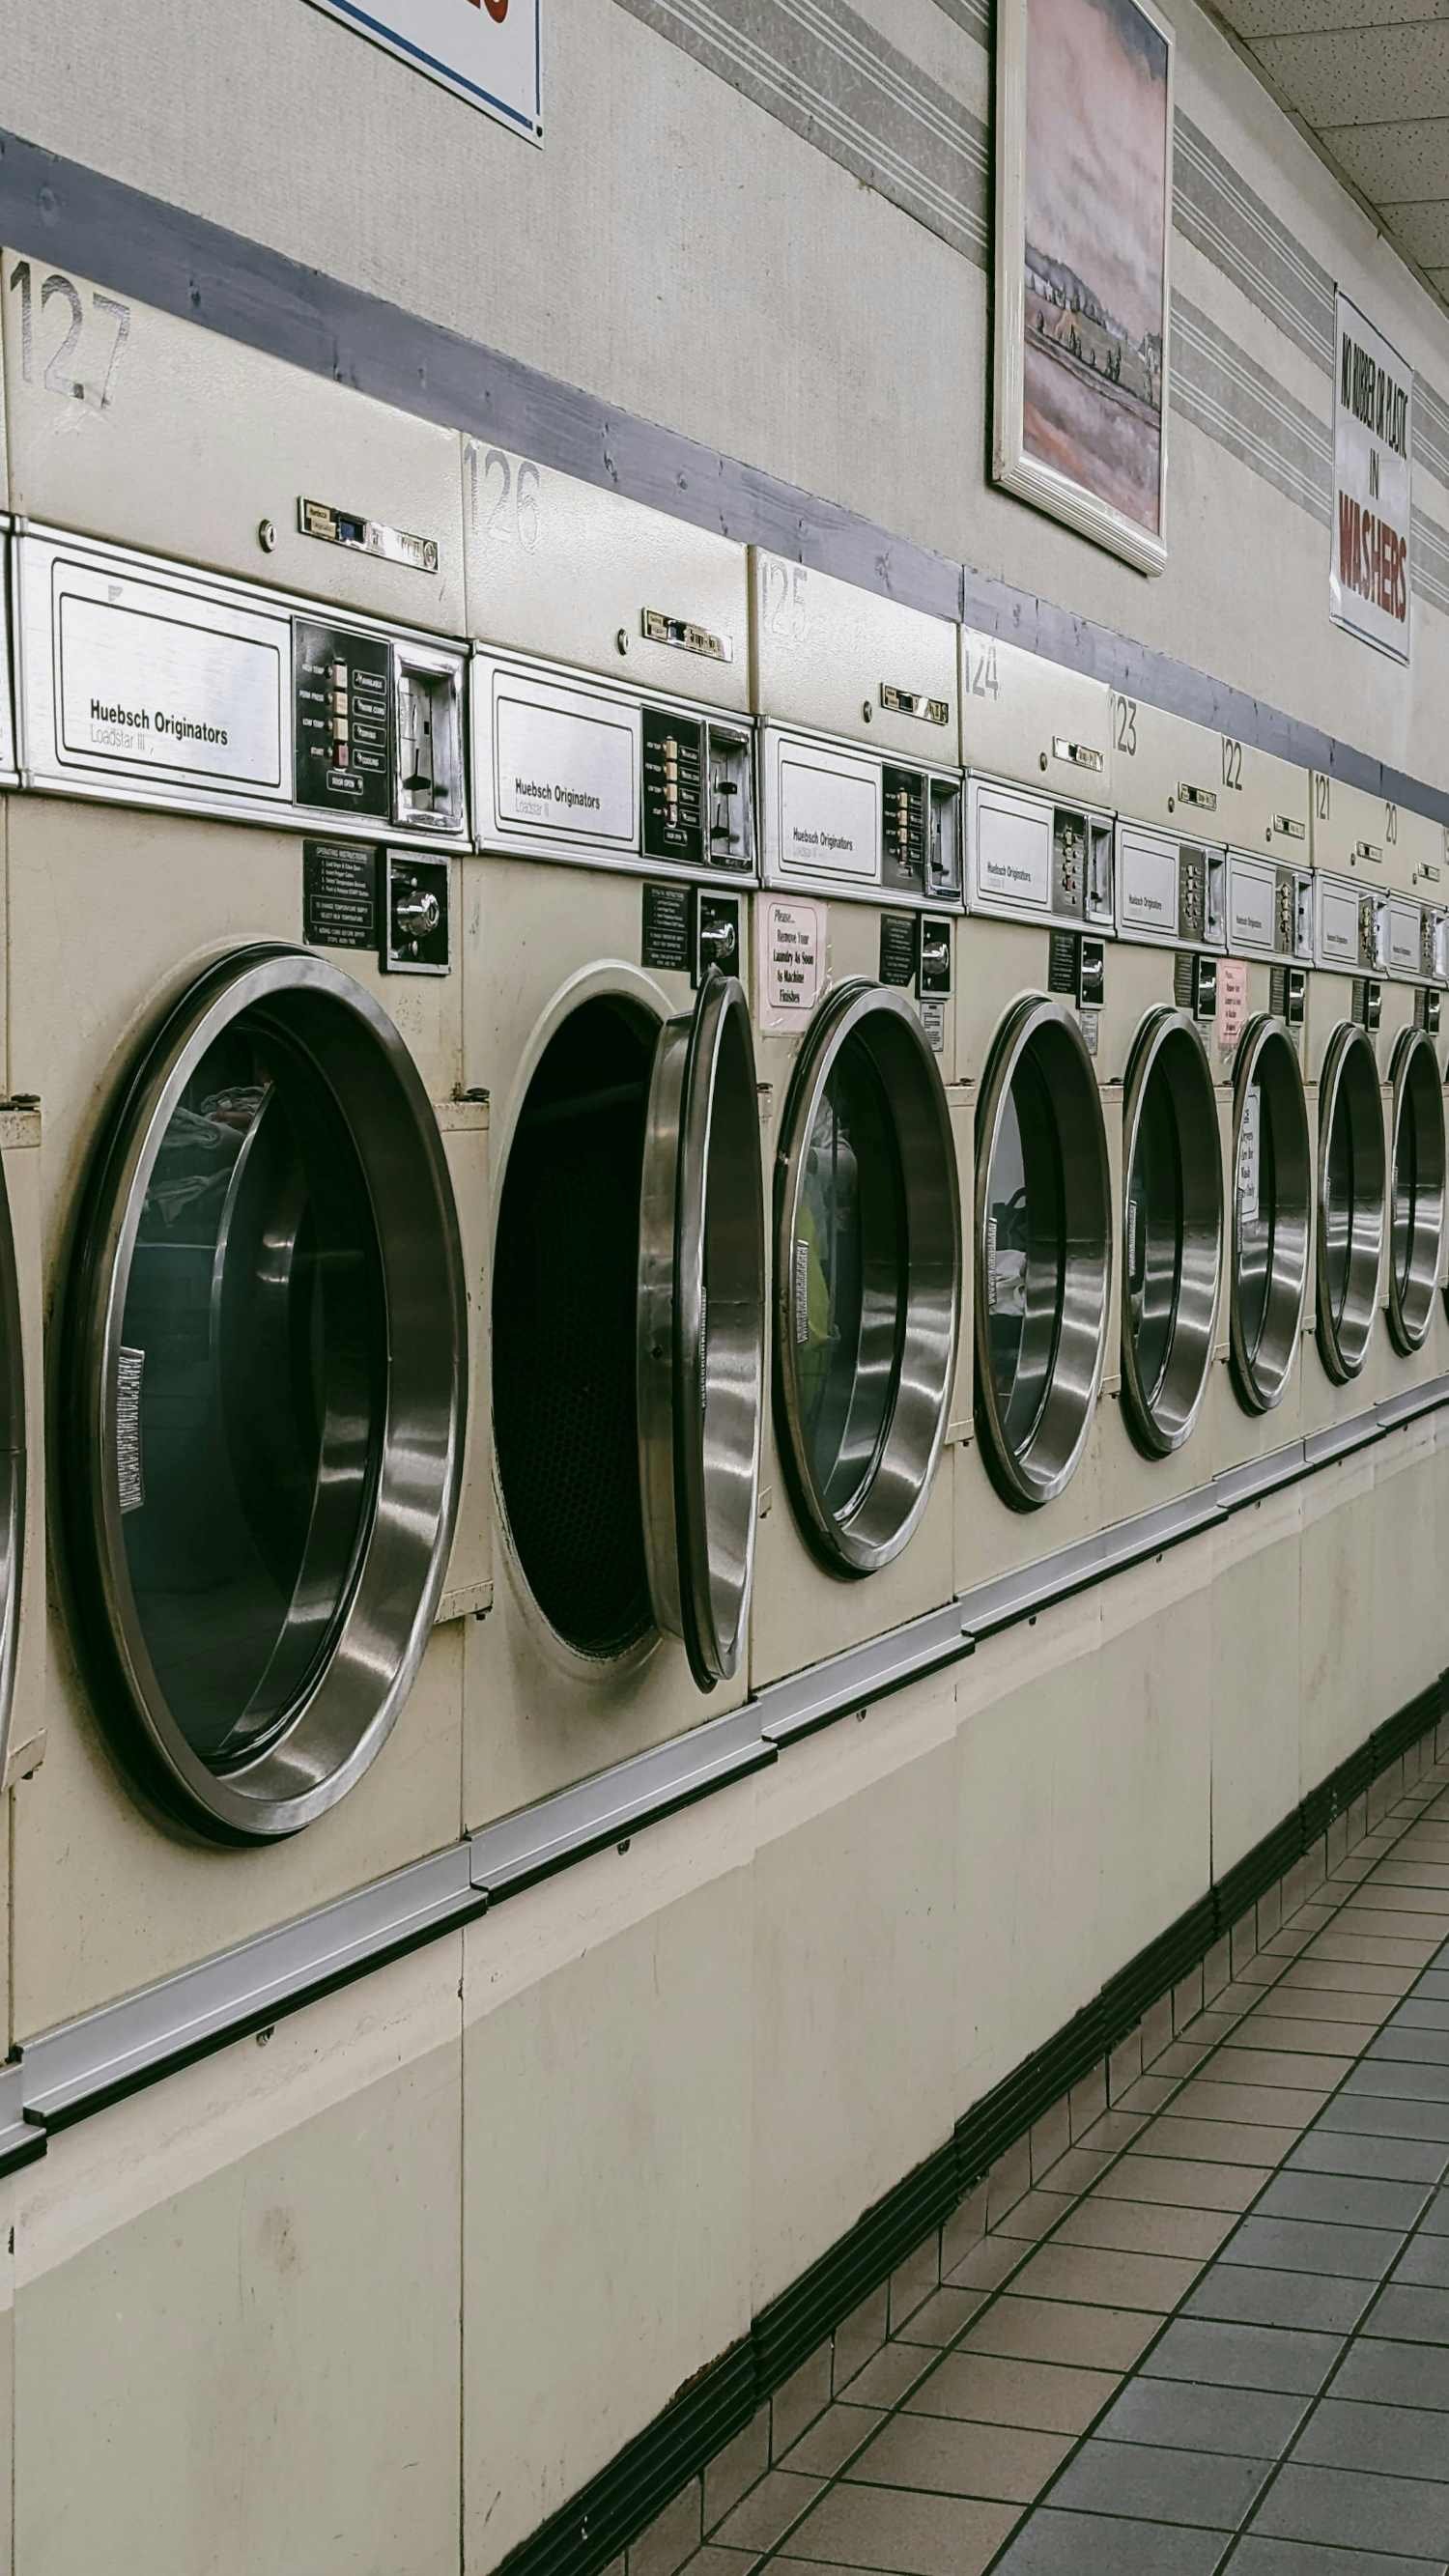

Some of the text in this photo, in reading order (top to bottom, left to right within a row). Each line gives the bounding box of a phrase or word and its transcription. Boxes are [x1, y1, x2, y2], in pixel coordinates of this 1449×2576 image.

[10, 260, 131, 410] 127
[1341, 332, 1352, 410] NO
[1369, 447, 1379, 500] IN
[1339, 490, 1407, 624] WASHERS
[90, 697, 229, 747] Huebsch Originators
[1221, 735, 1243, 791] 122
[515, 777, 553, 801] Huebsch
[554, 784, 601, 810] Originators
[1315, 774, 1330, 821] 121
[792, 826, 819, 845] Huebsch
[819, 831, 853, 852] Originators
[773, 948, 793, 966] Laundry
[802, 951, 813, 965] Soon
[777, 929, 810, 945] Remove Your
[780, 988, 800, 1004] Finishes
[783, 970, 804, 983] Machine
